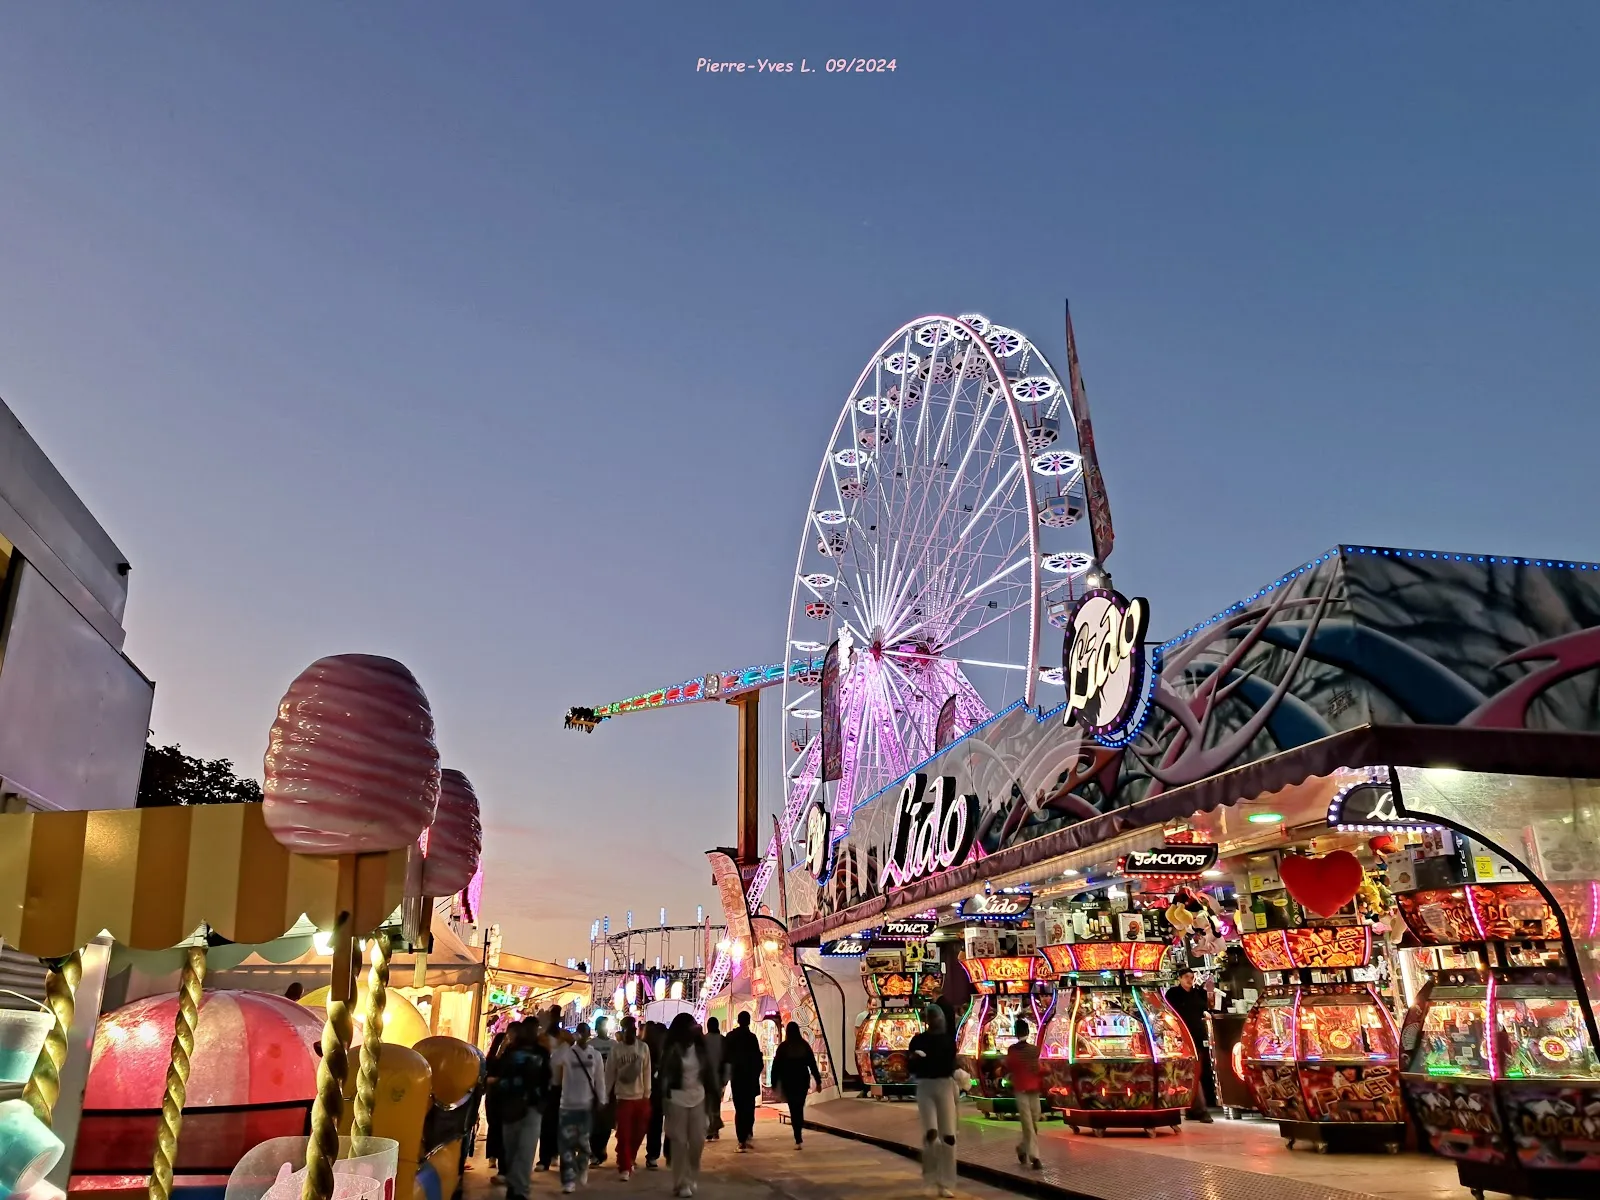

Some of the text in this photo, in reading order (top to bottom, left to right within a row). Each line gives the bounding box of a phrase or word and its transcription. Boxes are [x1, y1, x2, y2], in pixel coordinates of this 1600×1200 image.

[1063, 598, 1142, 726] Lido
[880, 772, 967, 889] Lido
[1130, 850, 1207, 866] JACKPOT
[976, 894, 1018, 914] Lido
[886, 923, 929, 933] POKER
[832, 939, 863, 954] Lido
[1302, 938, 1360, 965] POKER
[1363, 1065, 1391, 1079] ACE
[1315, 1078, 1394, 1116] POKER
